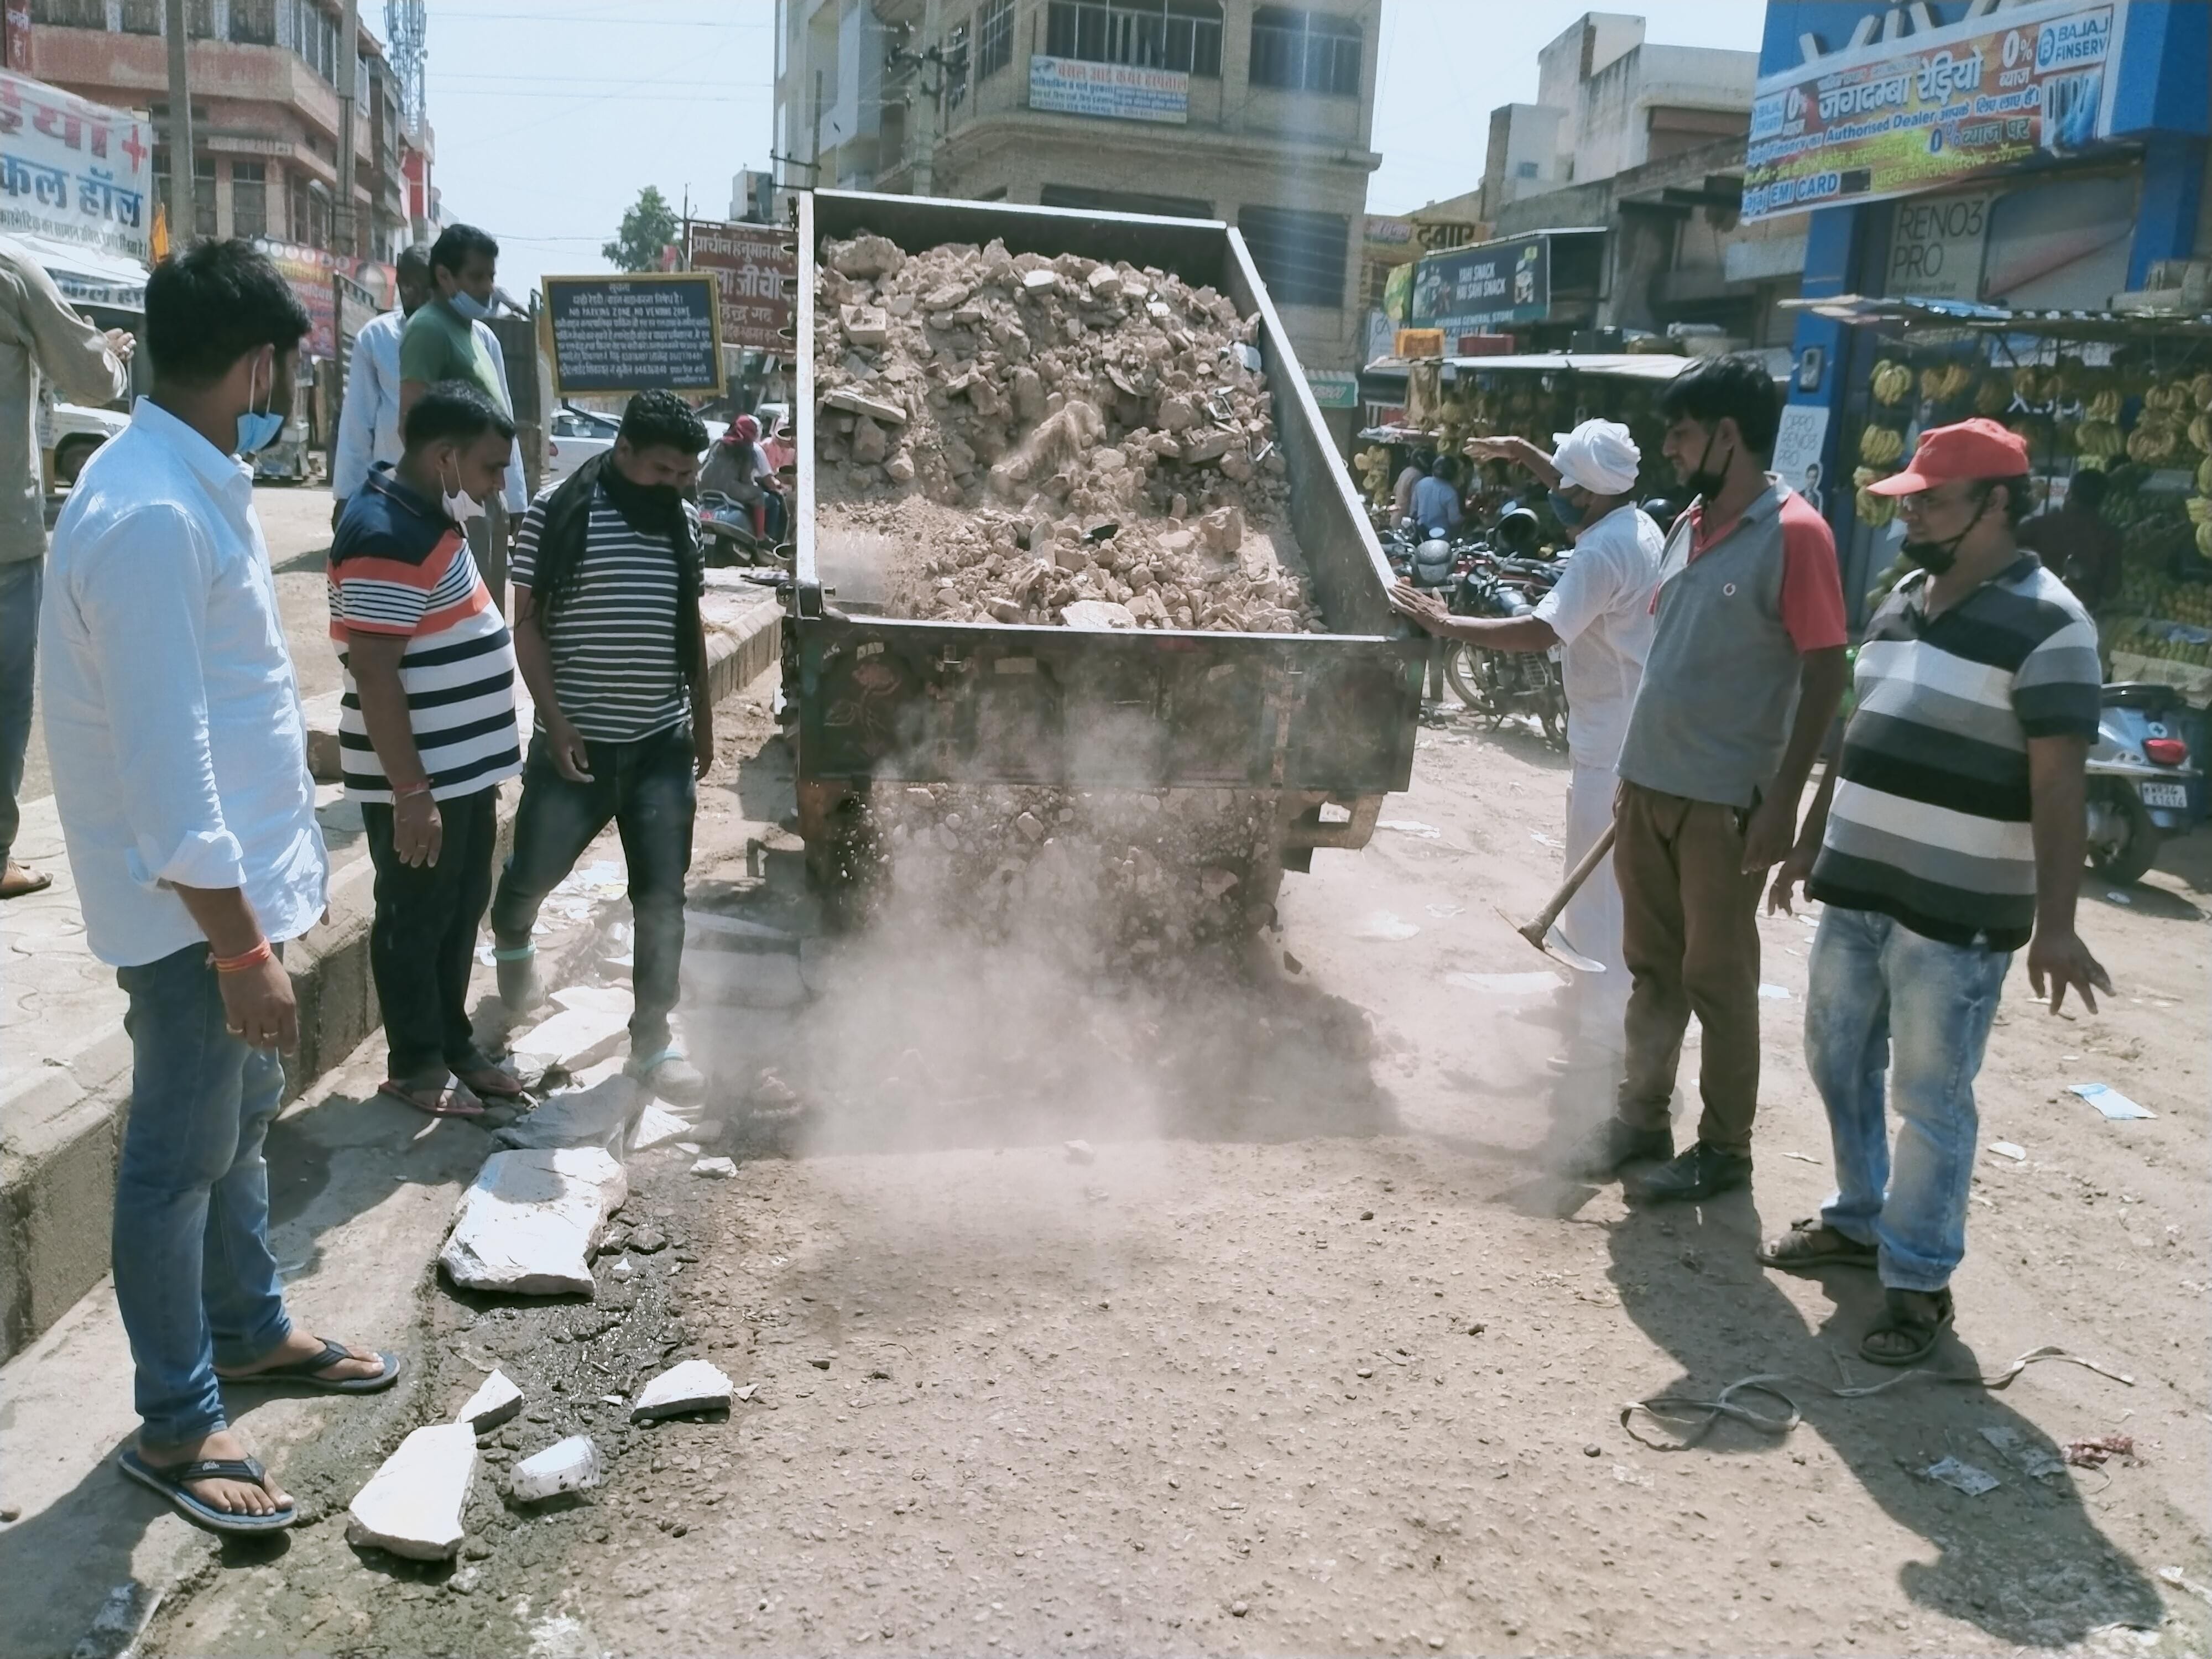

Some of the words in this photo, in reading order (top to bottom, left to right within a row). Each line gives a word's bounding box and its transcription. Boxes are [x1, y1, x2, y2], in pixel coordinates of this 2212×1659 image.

[2058, 17, 2109, 42] BAJAJ
[2056, 38, 2106, 61] FINSERV
[1818, 73, 1911, 120] जगदम्बा
[1916, 45, 1985, 105] रेडियो
[1827, 118, 1889, 142] Authorised
[1893, 110, 1935, 128] Dealer
[1772, 181, 1794, 204] EMI
[1798, 173, 1838, 197] CARD
[1897, 200, 1984, 241] RENO3
[693, 233, 732, 255] प्राचीन
[1892, 242, 1943, 278] PRO
